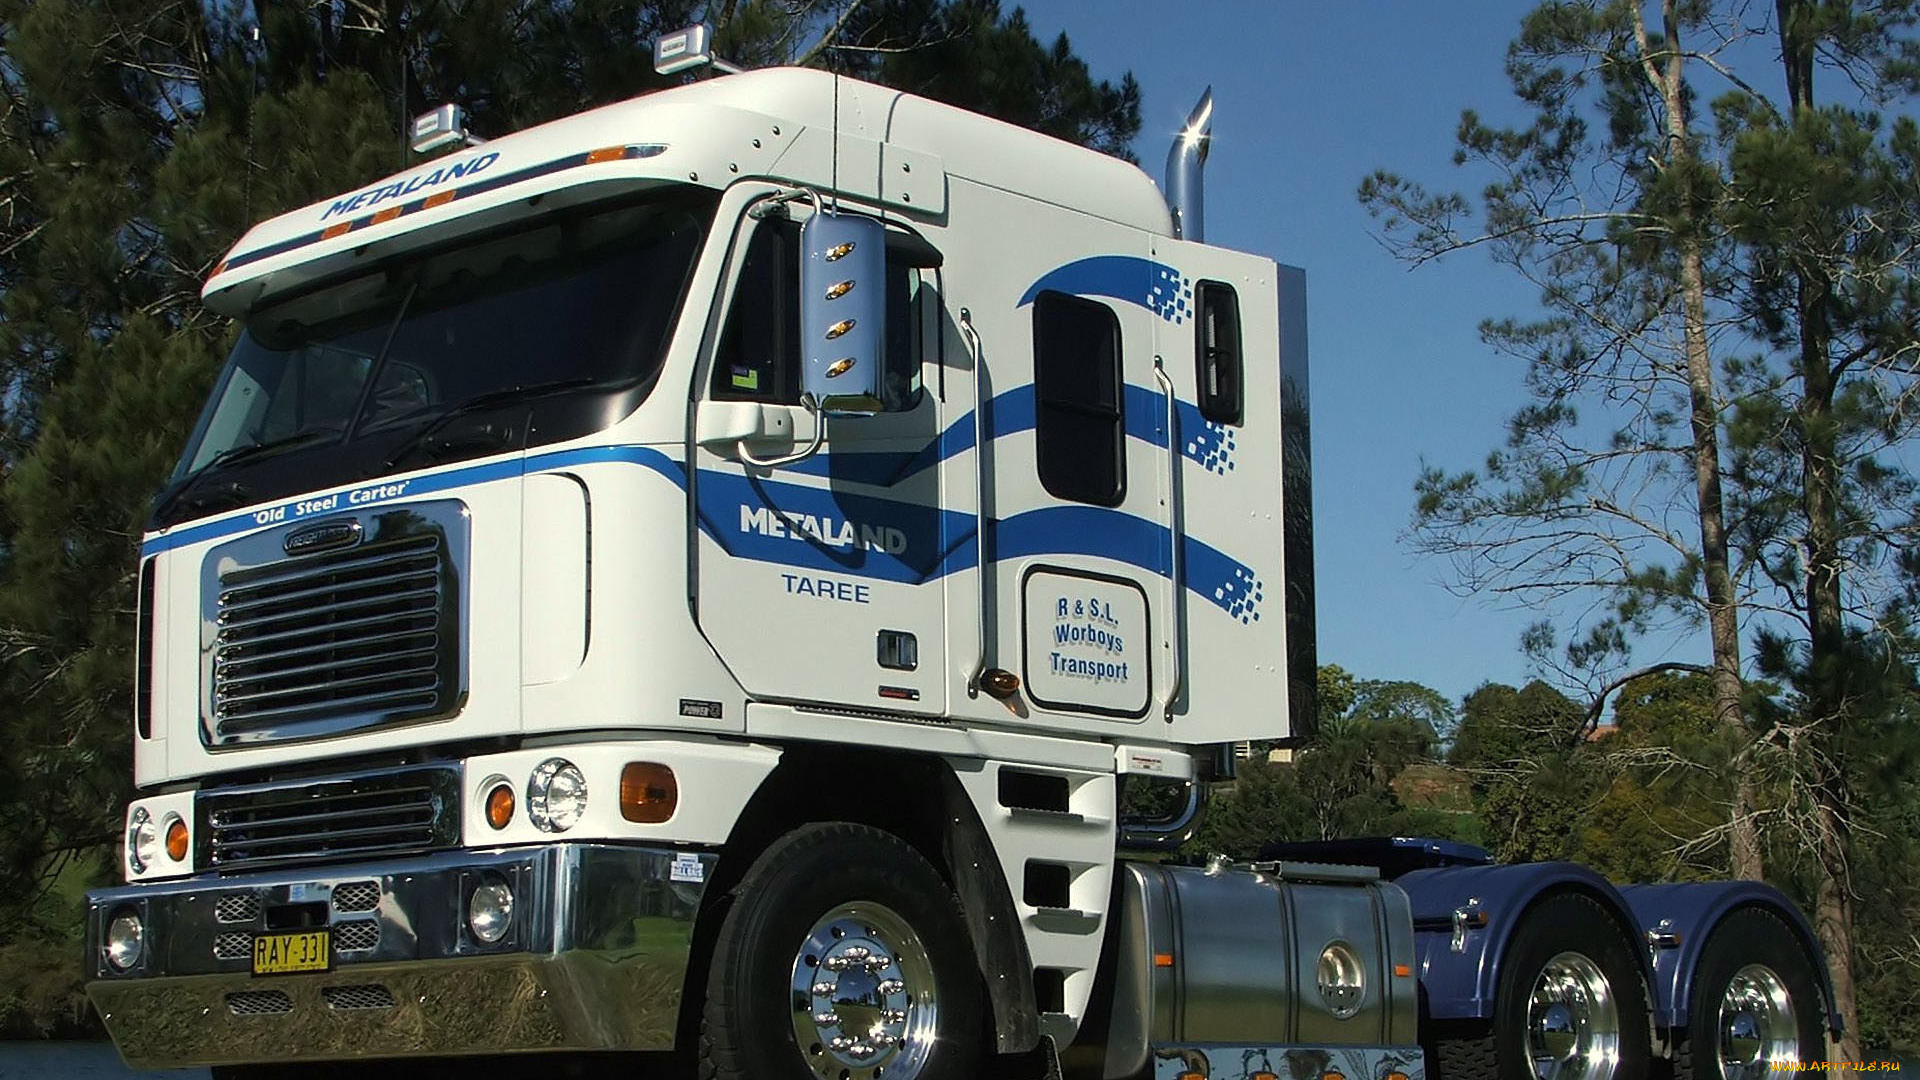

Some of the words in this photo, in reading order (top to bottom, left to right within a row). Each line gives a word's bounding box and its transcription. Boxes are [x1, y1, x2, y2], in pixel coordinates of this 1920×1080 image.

[320, 152, 500, 221] METALAND
[296, 495, 338, 516] Steel
[740, 504, 908, 555] METALAND
[781, 573, 870, 604] TAREE
[1058, 598, 1068, 616] R
[1075, 600, 1084, 615] &
[1056, 624, 1123, 653] Worboys
[1051, 652, 1128, 680] Transport
